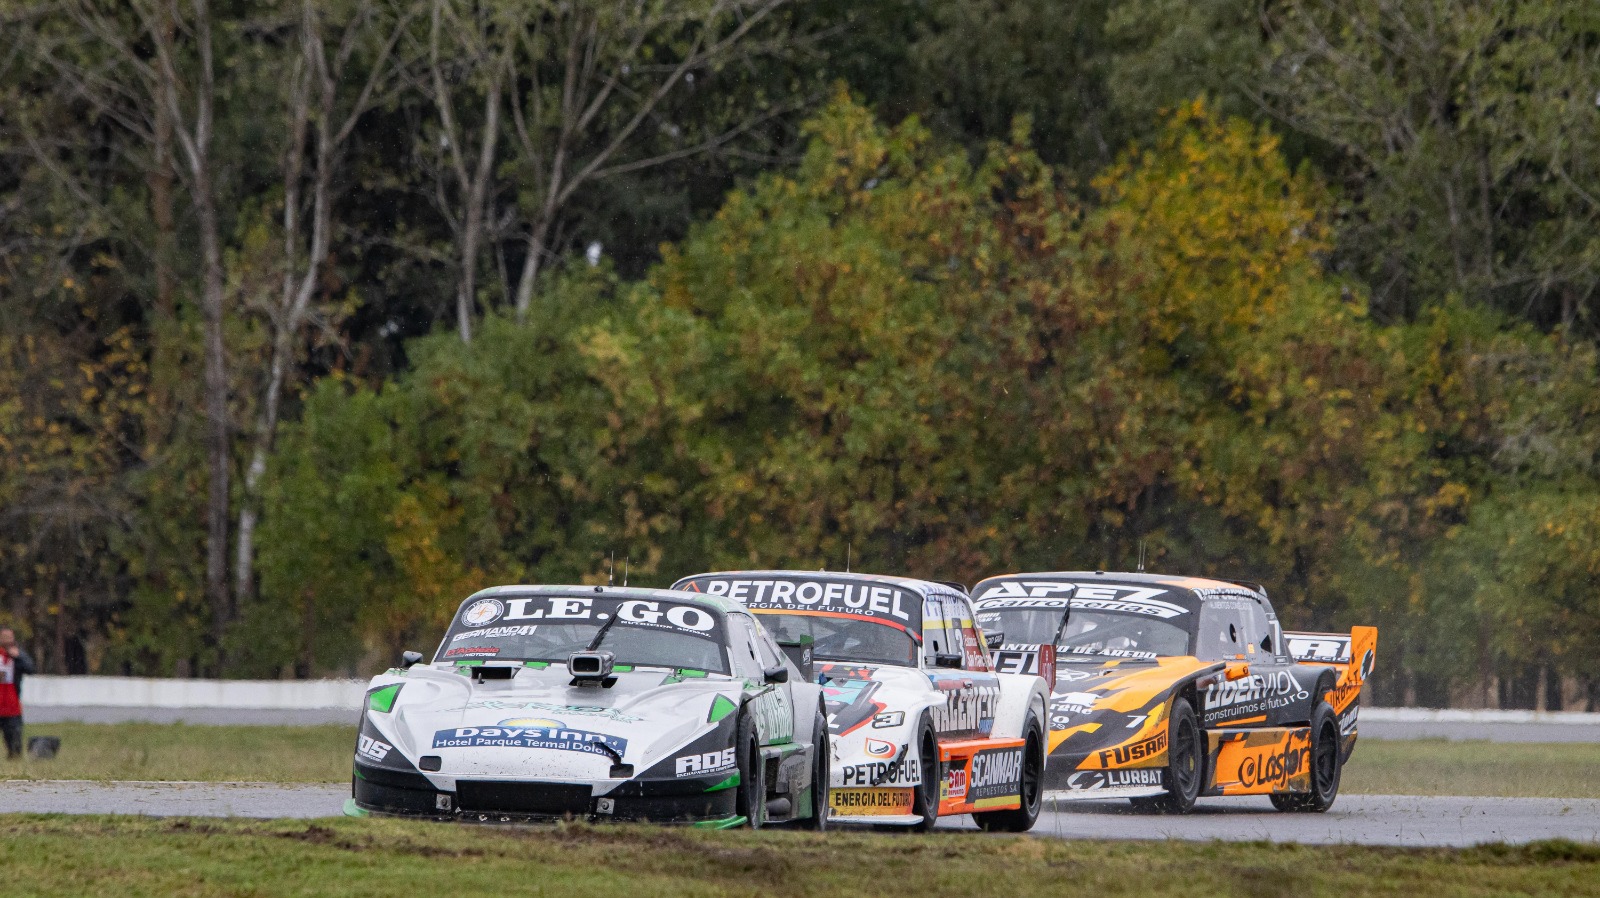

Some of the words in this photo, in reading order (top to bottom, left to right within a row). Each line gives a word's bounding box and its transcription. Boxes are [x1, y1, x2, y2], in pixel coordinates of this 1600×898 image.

[706, 580, 909, 621] PETROFUEL
[977, 581, 1189, 614] APEZ
[817, 605, 874, 616] FUTURO
[1204, 703, 1259, 722] construimos
[1260, 701, 1268, 711] el
[1267, 690, 1310, 709] futuro
[1125, 714, 1148, 728] 7
[435, 738, 472, 747] Hotel
[476, 738, 522, 748] Parque
[525, 738, 570, 749] Termal
[455, 728, 542, 738] Days
[549, 729, 607, 743] Inn
[1099, 730, 1167, 769] FUSARI
[675, 746, 736, 775] RDS
[970, 750, 1022, 788] SCANMAR
[842, 760, 920, 786] PETROFUEL
[1107, 770, 1162, 786] LURBAT
[835, 792, 876, 807] ENERGIA
[877, 792, 892, 807] DEL
[892, 792, 912, 806] FUTURO
[975, 785, 1008, 797] REPUESTOS
